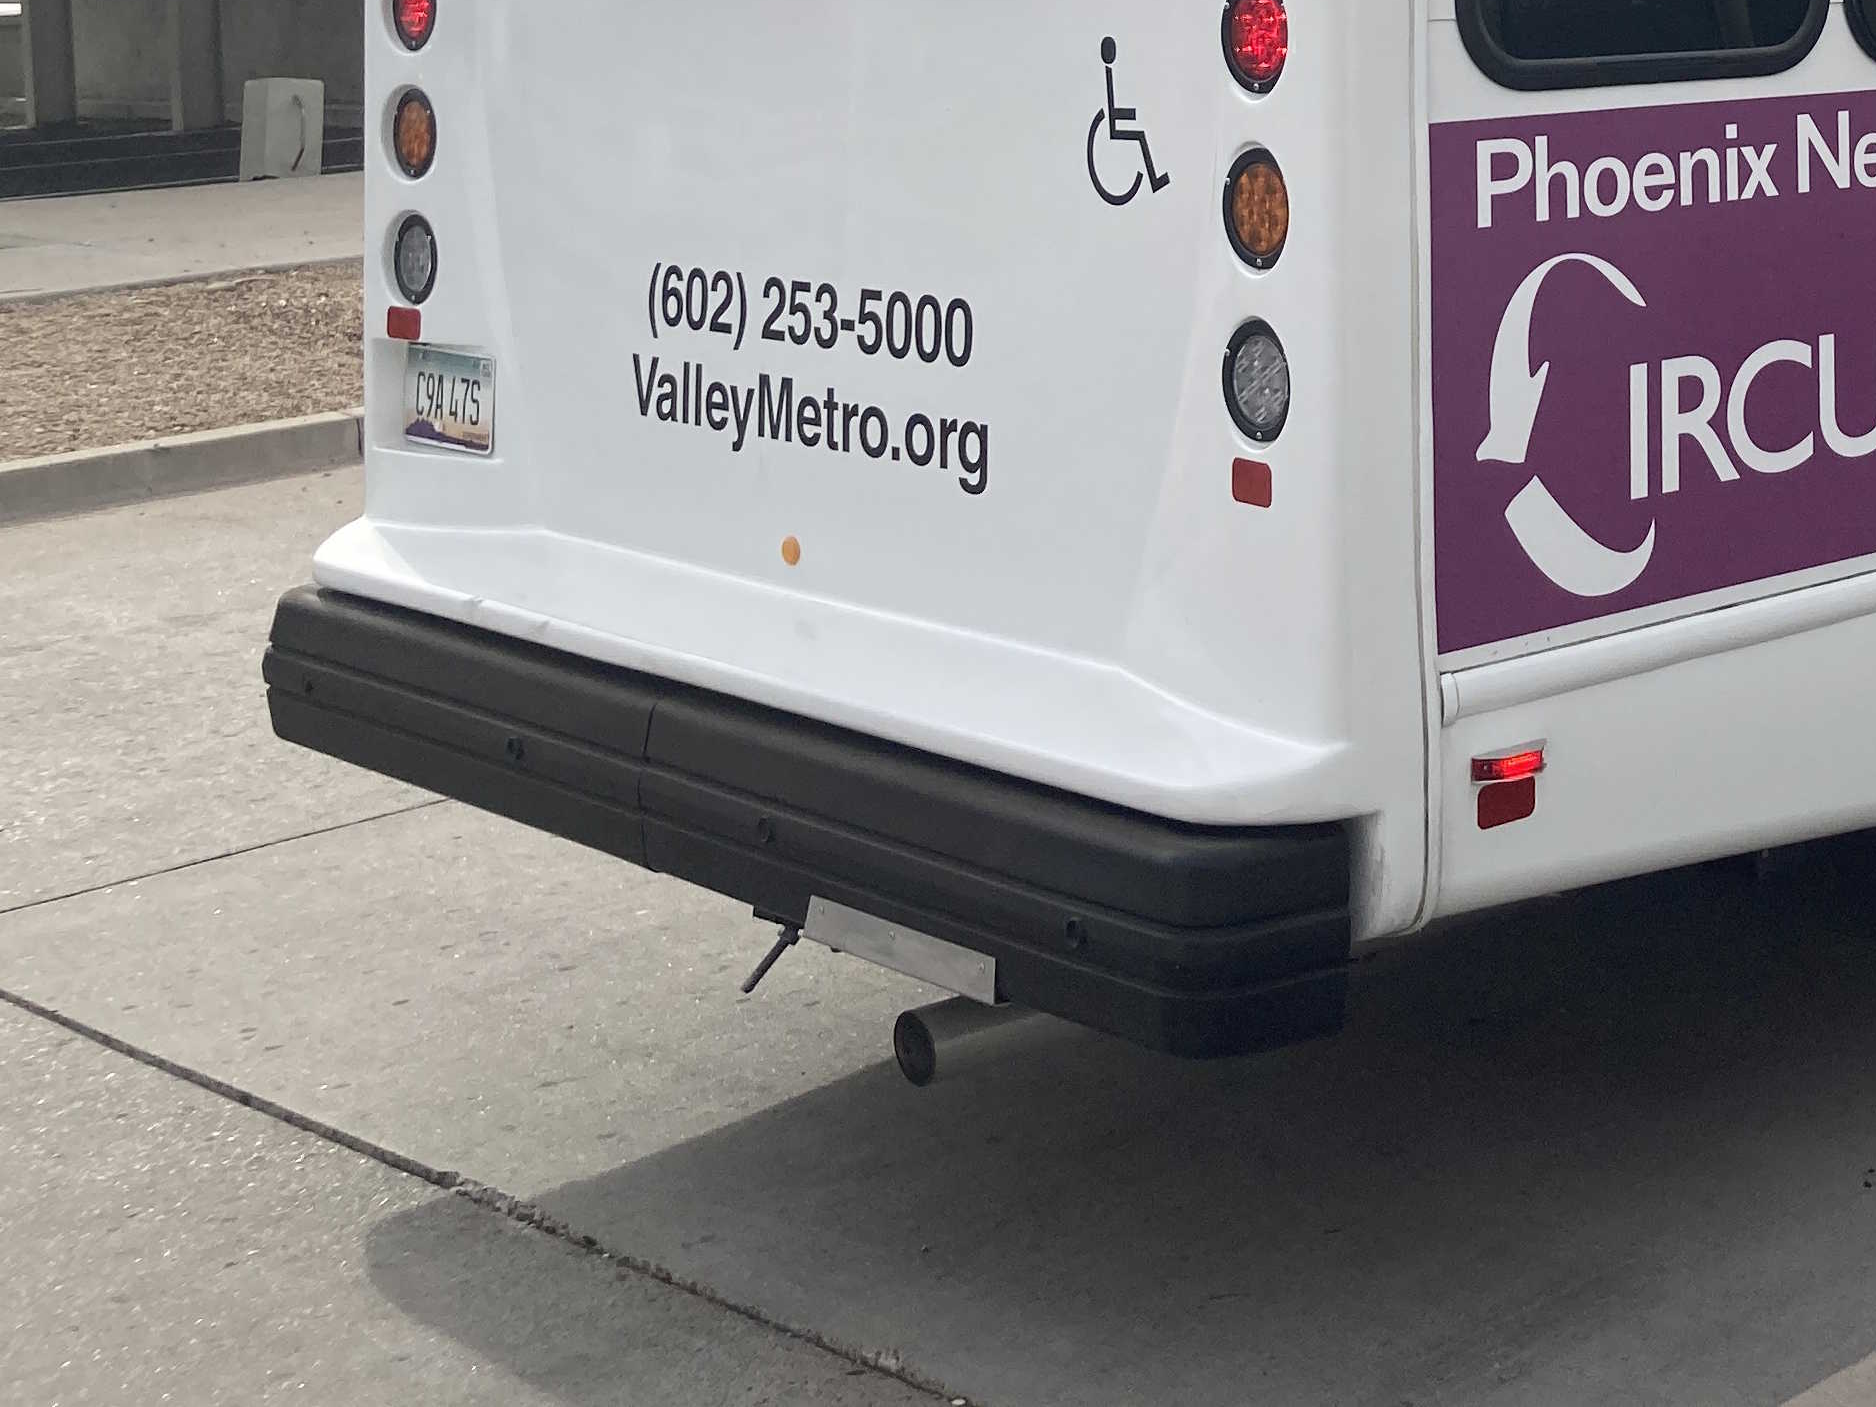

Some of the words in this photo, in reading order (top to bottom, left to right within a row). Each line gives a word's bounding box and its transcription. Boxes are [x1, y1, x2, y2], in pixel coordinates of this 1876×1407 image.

[1476, 123, 1779, 229] Phoenix
[648, 262, 748, 351] (602)
[761, 276, 973, 367] 253-5000
[632, 353, 989, 495] ValleyMetro.org
